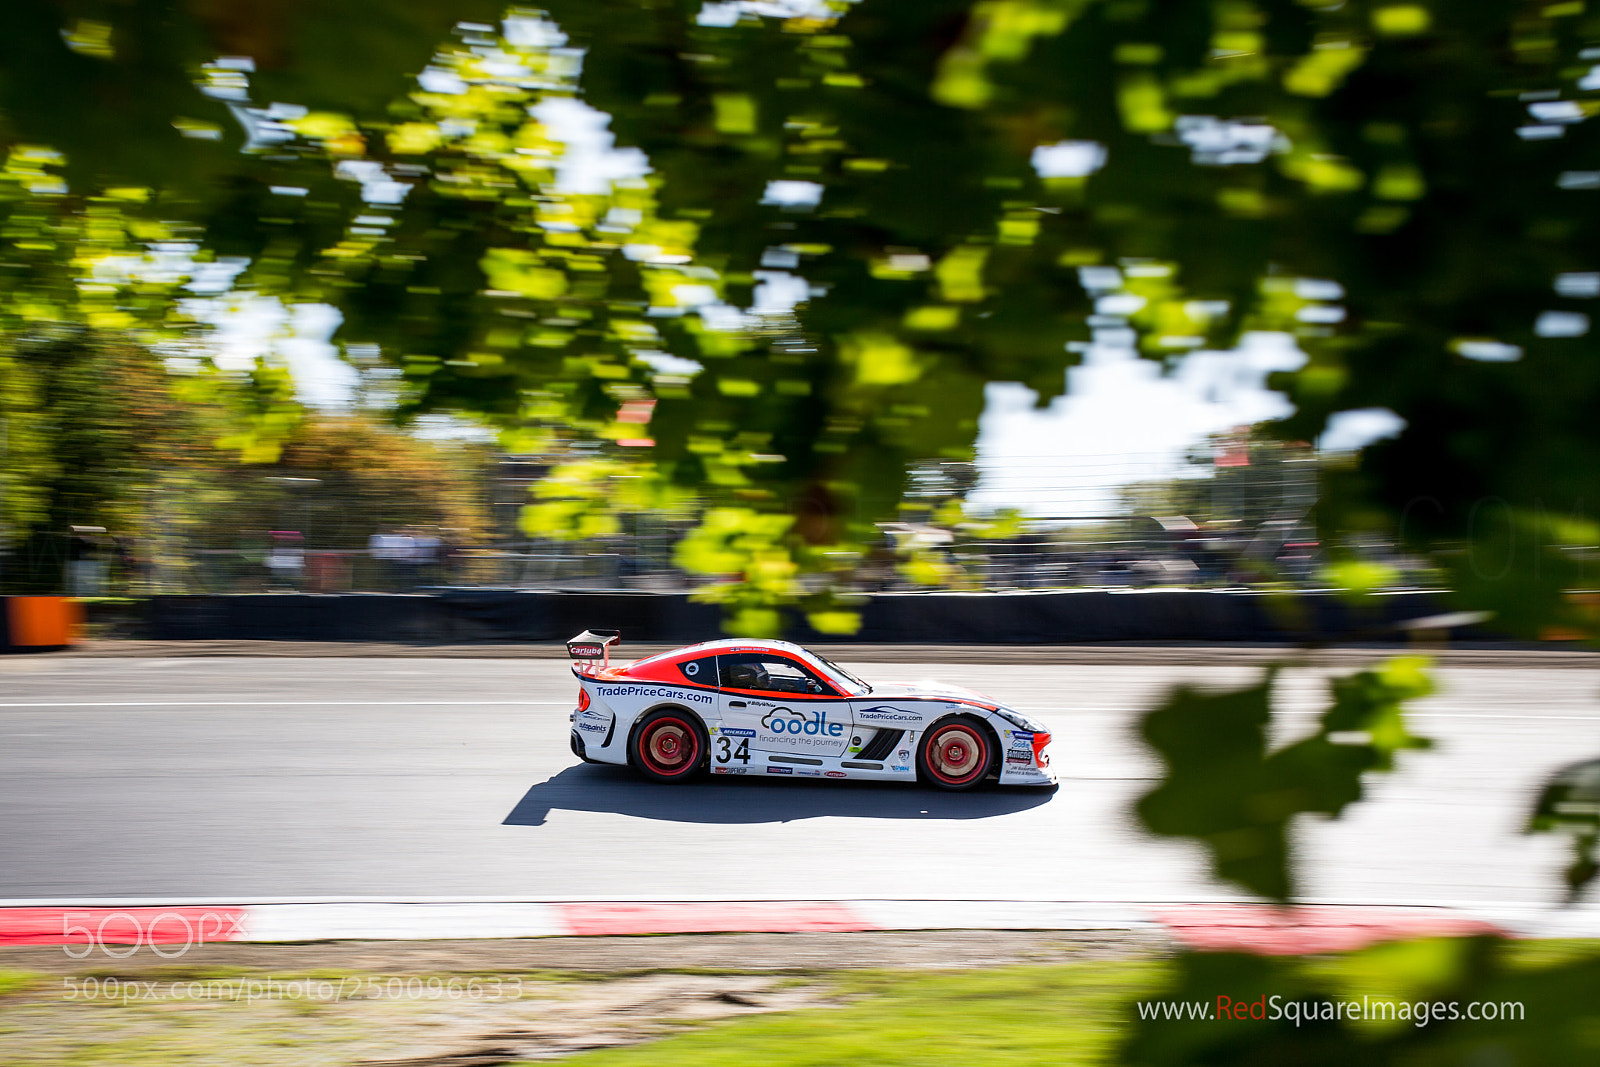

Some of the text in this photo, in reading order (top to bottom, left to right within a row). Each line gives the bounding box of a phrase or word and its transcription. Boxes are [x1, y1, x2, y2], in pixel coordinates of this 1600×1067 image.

[570, 647, 602, 655] Carlube
[596, 686, 713, 704] TradePriceCars.com
[770, 711, 844, 737] oodle
[859, 712, 923, 721] TradePriceCars.com
[759, 735, 797, 745] financing
[798, 737, 812, 745] the
[813, 739, 844, 748] journey
[715, 736, 751, 765] 34
